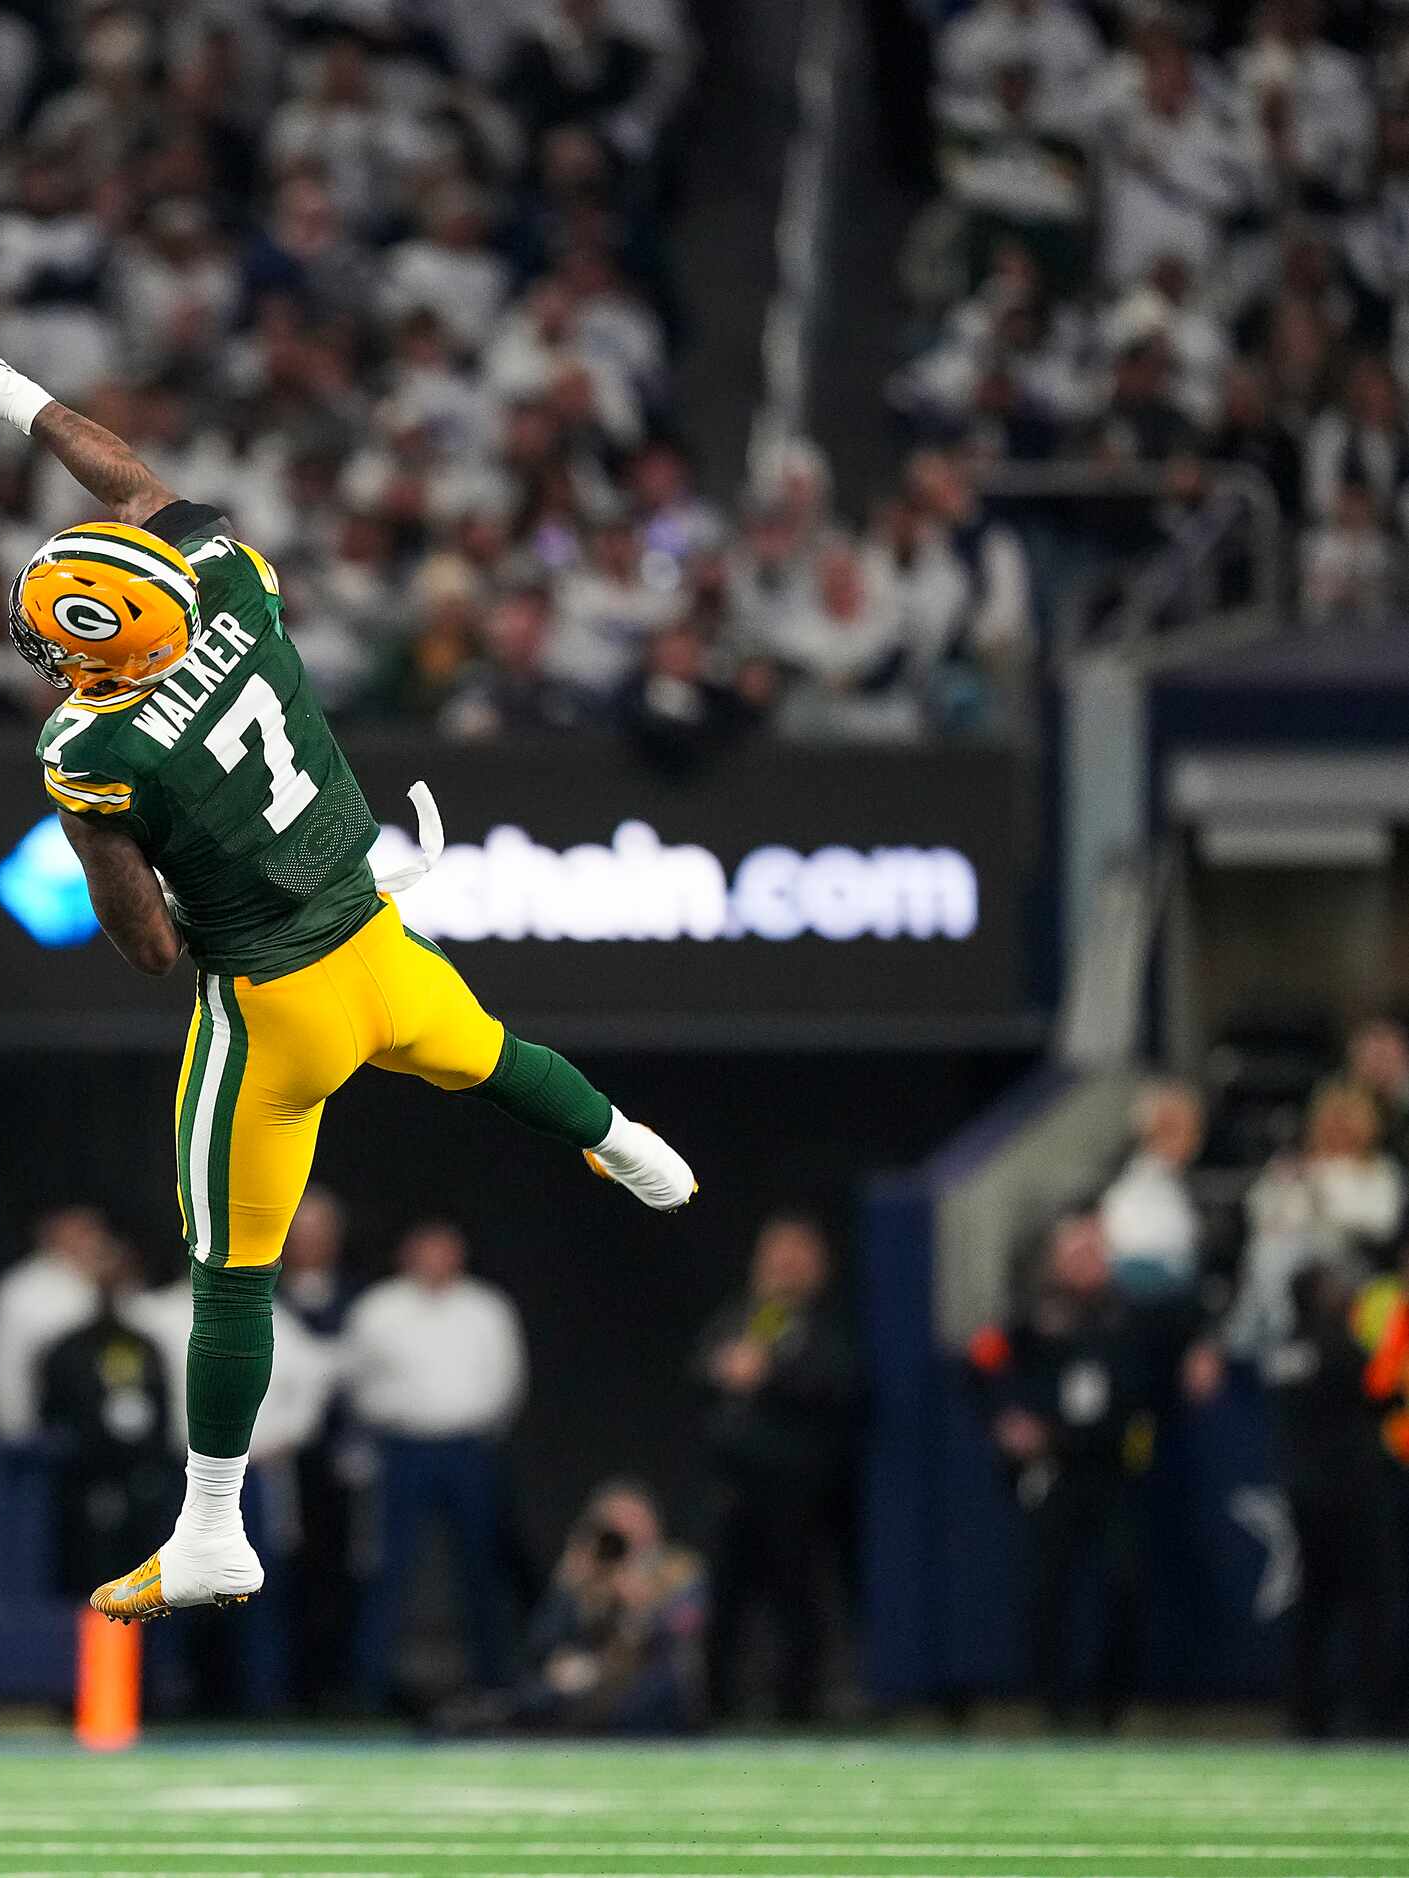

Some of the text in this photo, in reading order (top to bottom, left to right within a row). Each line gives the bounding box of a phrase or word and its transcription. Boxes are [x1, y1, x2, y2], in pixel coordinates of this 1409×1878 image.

[54, 596, 120, 641] G
[132, 612, 257, 750] WALKER
[43, 707, 98, 764] 7
[203, 673, 319, 834] 7
